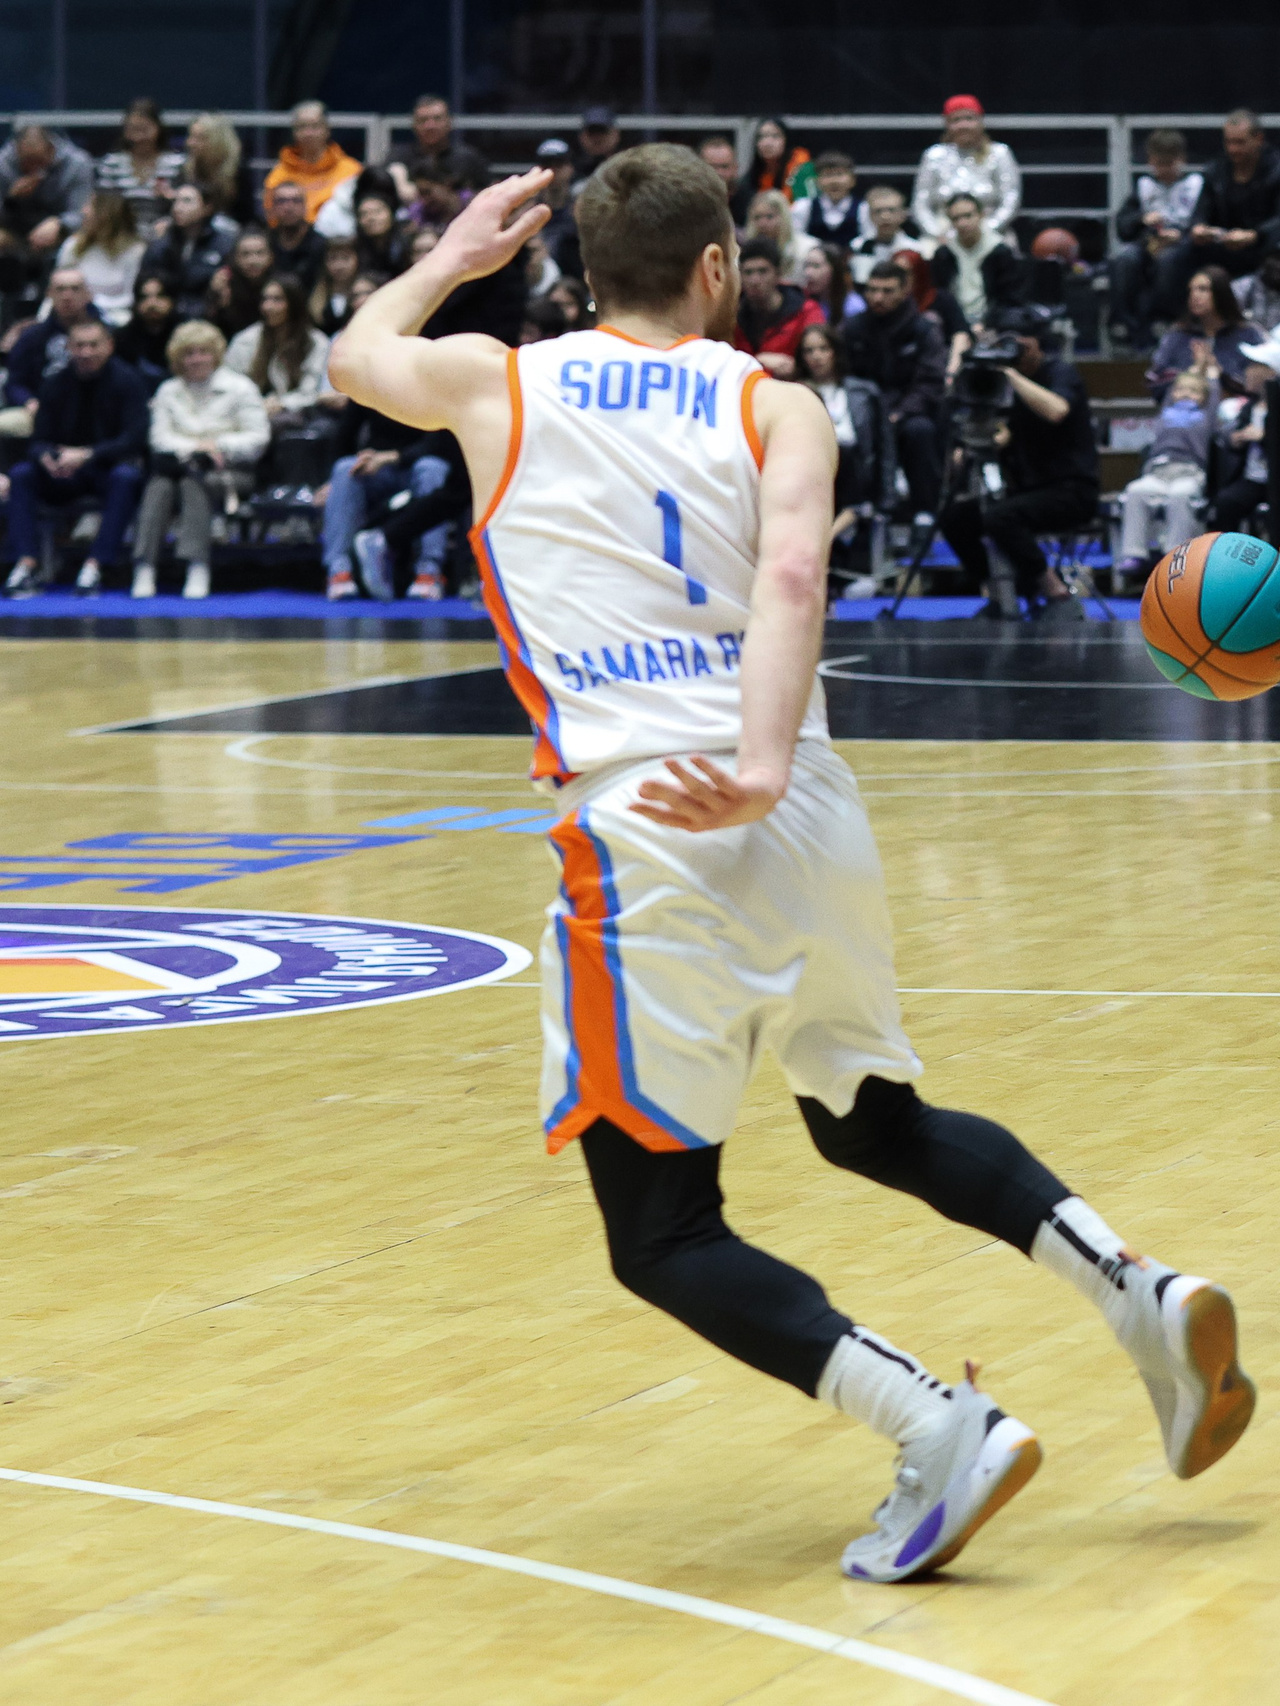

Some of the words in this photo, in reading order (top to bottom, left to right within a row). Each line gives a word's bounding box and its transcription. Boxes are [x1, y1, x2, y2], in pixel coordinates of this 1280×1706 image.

[560, 359, 718, 428] SOPIN
[655, 489, 708, 605] 1
[554, 637, 712, 692] SAMARA
